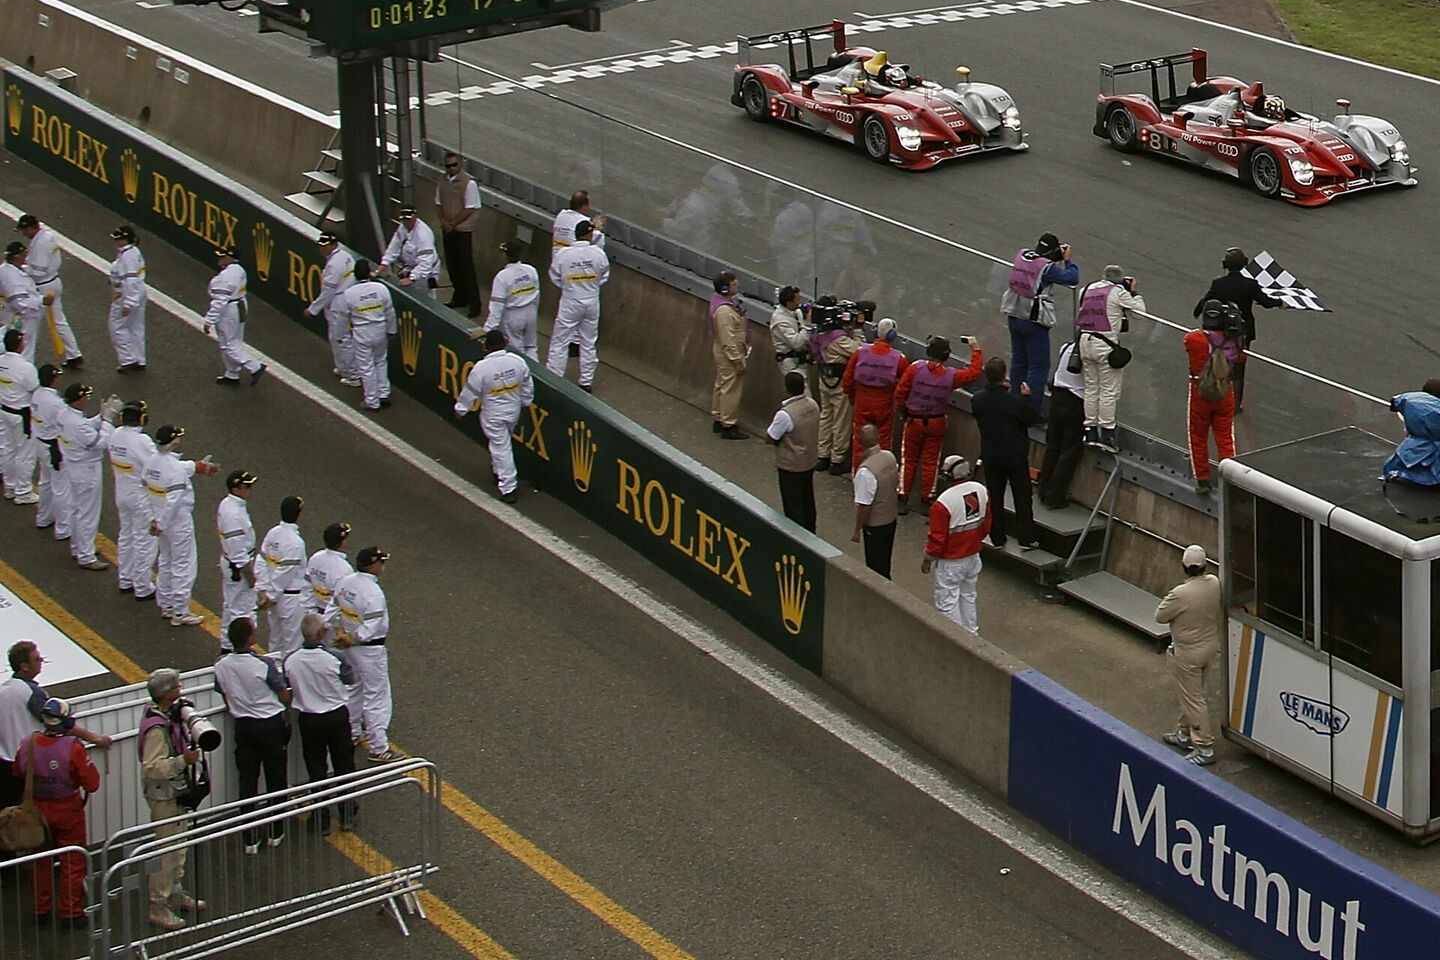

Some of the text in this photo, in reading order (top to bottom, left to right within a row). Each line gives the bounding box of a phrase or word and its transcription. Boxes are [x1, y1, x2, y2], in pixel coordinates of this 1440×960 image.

[992, 95, 1009, 104] TDI
[780, 102, 788, 118] 7
[894, 113, 912, 122] TDI
[1181, 132, 1217, 147] TDI Power
[1380, 128, 1398, 137] TDI
[32, 105, 109, 184] ROLEX
[1149, 133, 1162, 151] 8
[1284, 146, 1305, 156] TDI
[152, 171, 239, 250] ROLEX
[438, 342, 550, 462] ROX
[615, 455, 753, 598] ROLEX
[1285, 693, 1342, 731] LE MANS
[1112, 761, 1366, 960] Matmut
